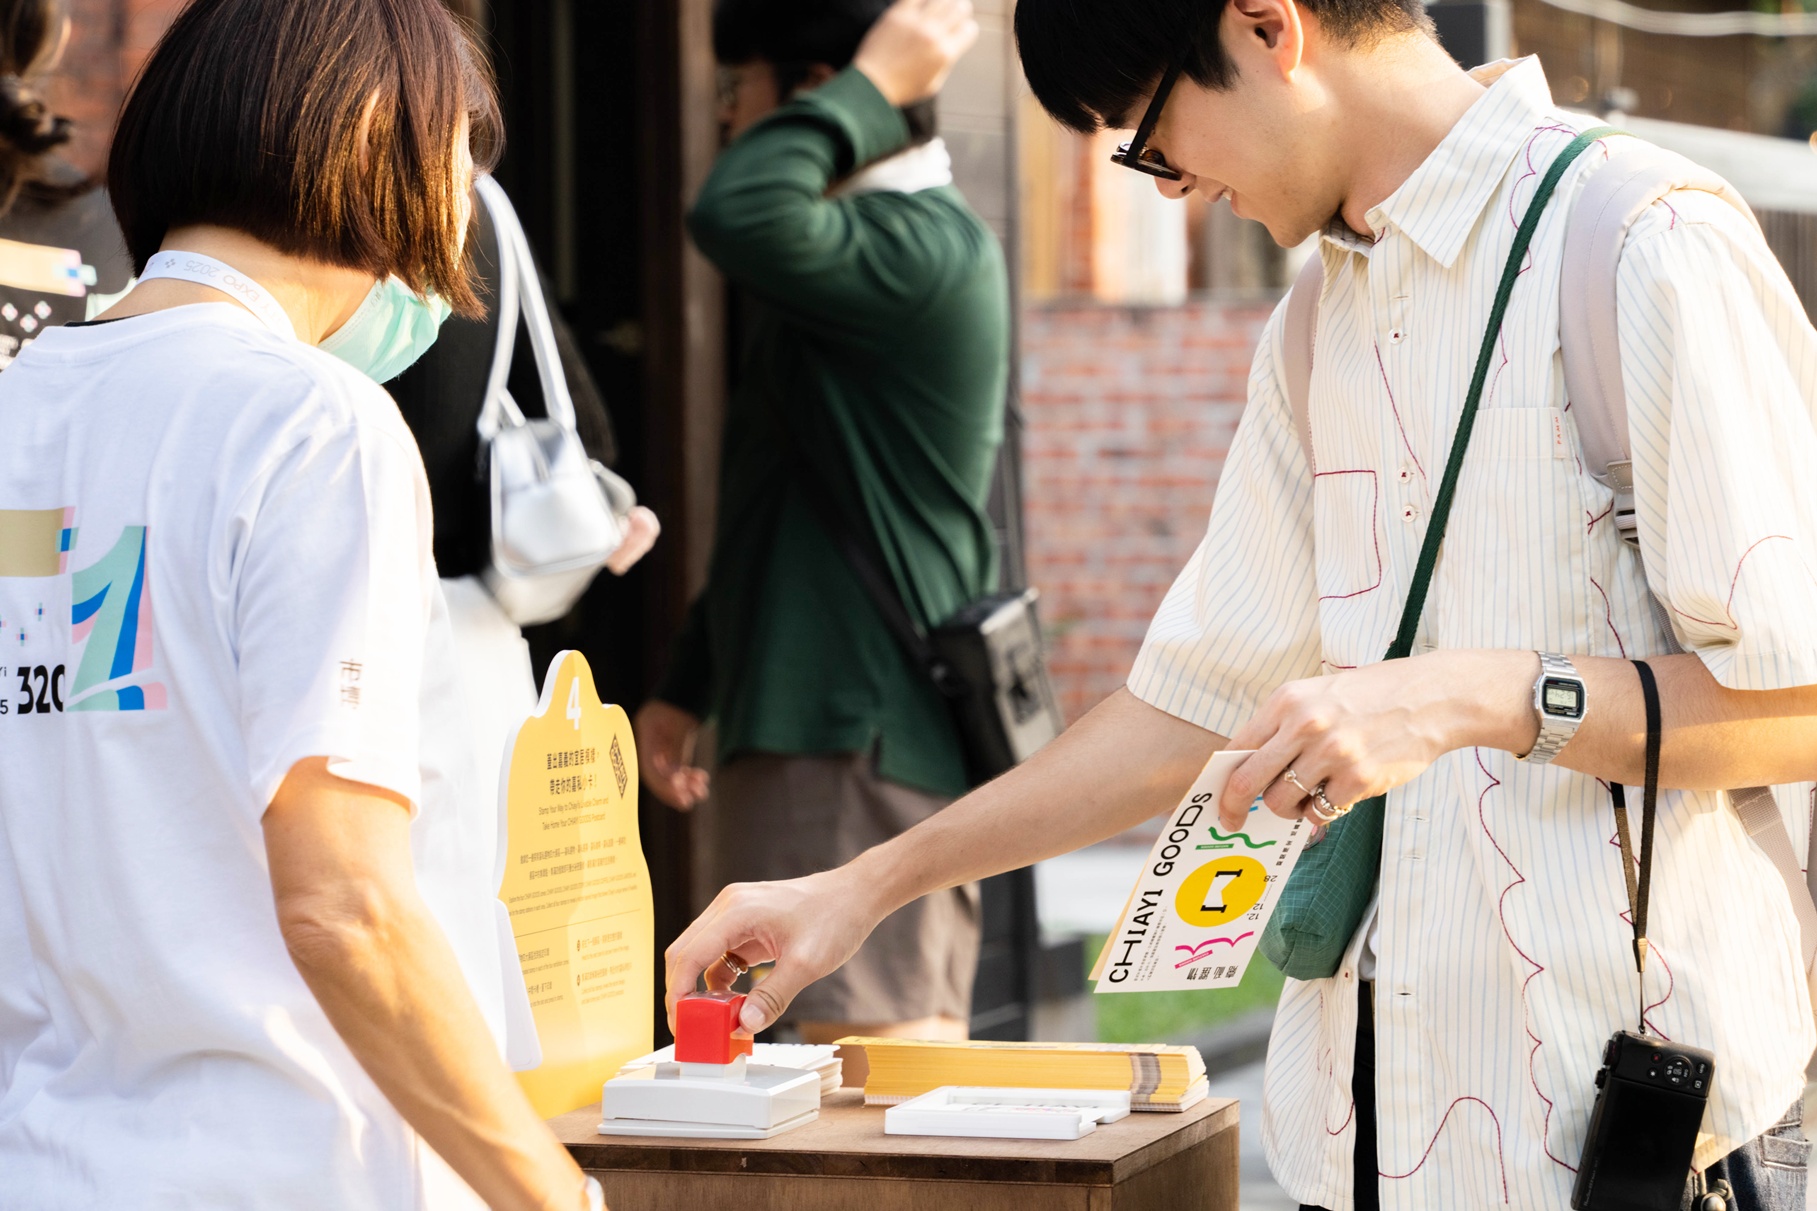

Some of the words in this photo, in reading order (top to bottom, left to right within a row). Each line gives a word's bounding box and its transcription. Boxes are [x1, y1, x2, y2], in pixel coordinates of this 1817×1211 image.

[183, 259, 220, 278] 2025
[222, 274, 260, 302] EXPO
[566, 677, 582, 731] 4
[1109, 889, 1163, 983] CHIAYI
[1153, 792, 1213, 877] GOODS
[1263, 874, 1278, 883] 28
[1252, 903, 1264, 911] 12
